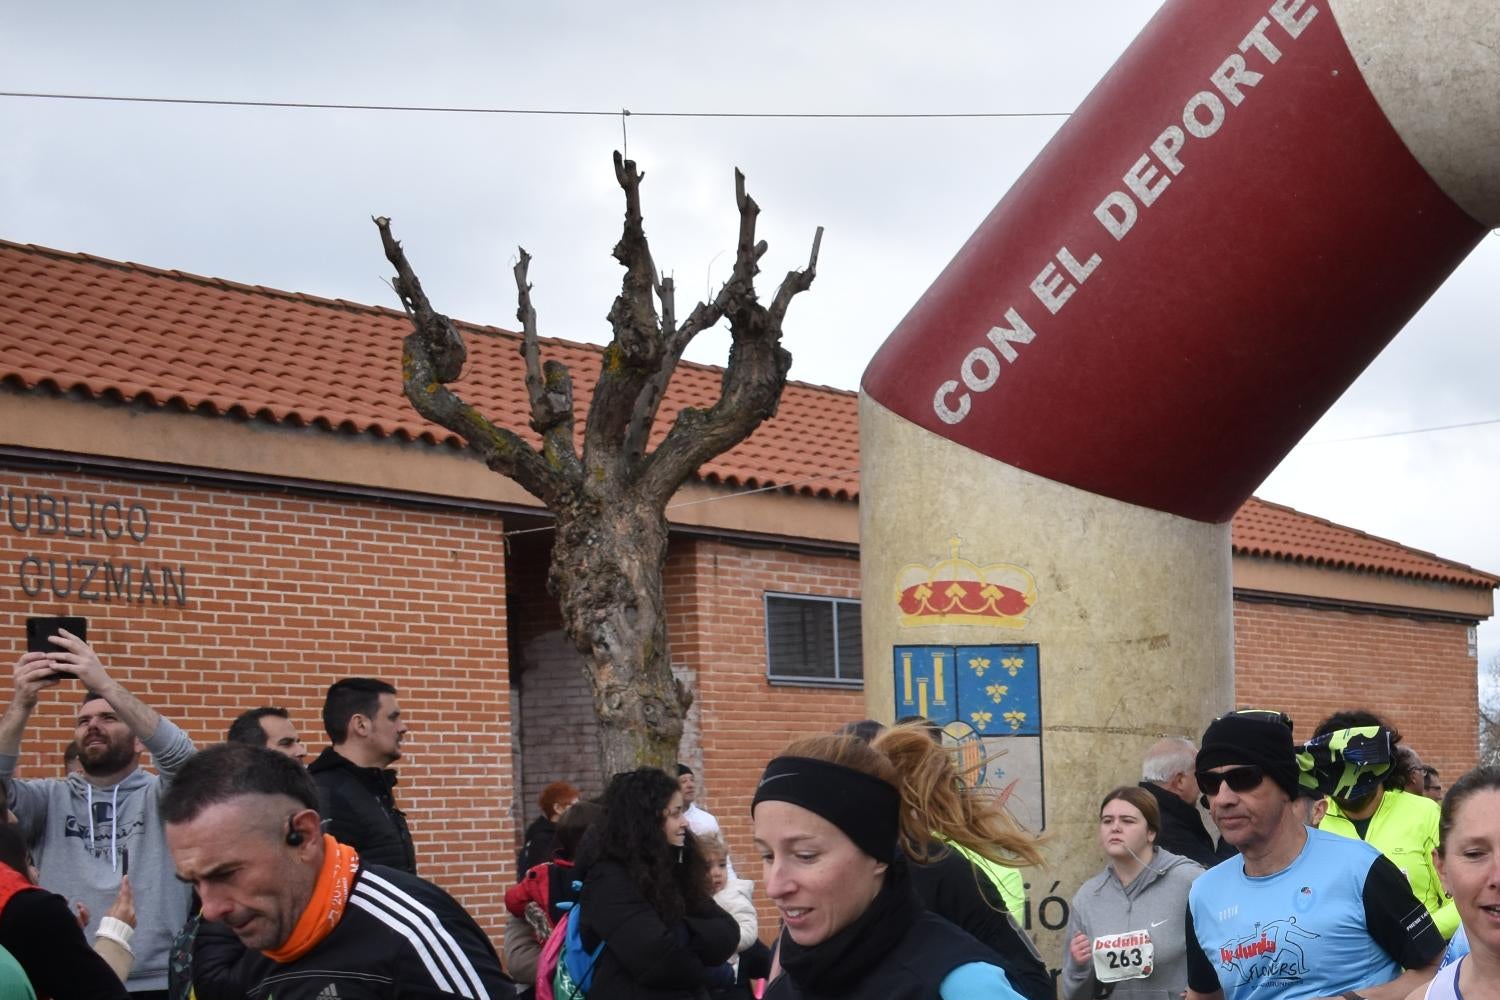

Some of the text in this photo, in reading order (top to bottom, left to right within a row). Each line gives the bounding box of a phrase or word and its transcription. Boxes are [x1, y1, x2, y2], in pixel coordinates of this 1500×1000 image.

[933, 0, 1319, 425] CON EL DEPORTE
[0, 493, 150, 542] UBLICO
[20, 556, 186, 606] GUZMAN
[1107, 948, 1143, 969] 263
